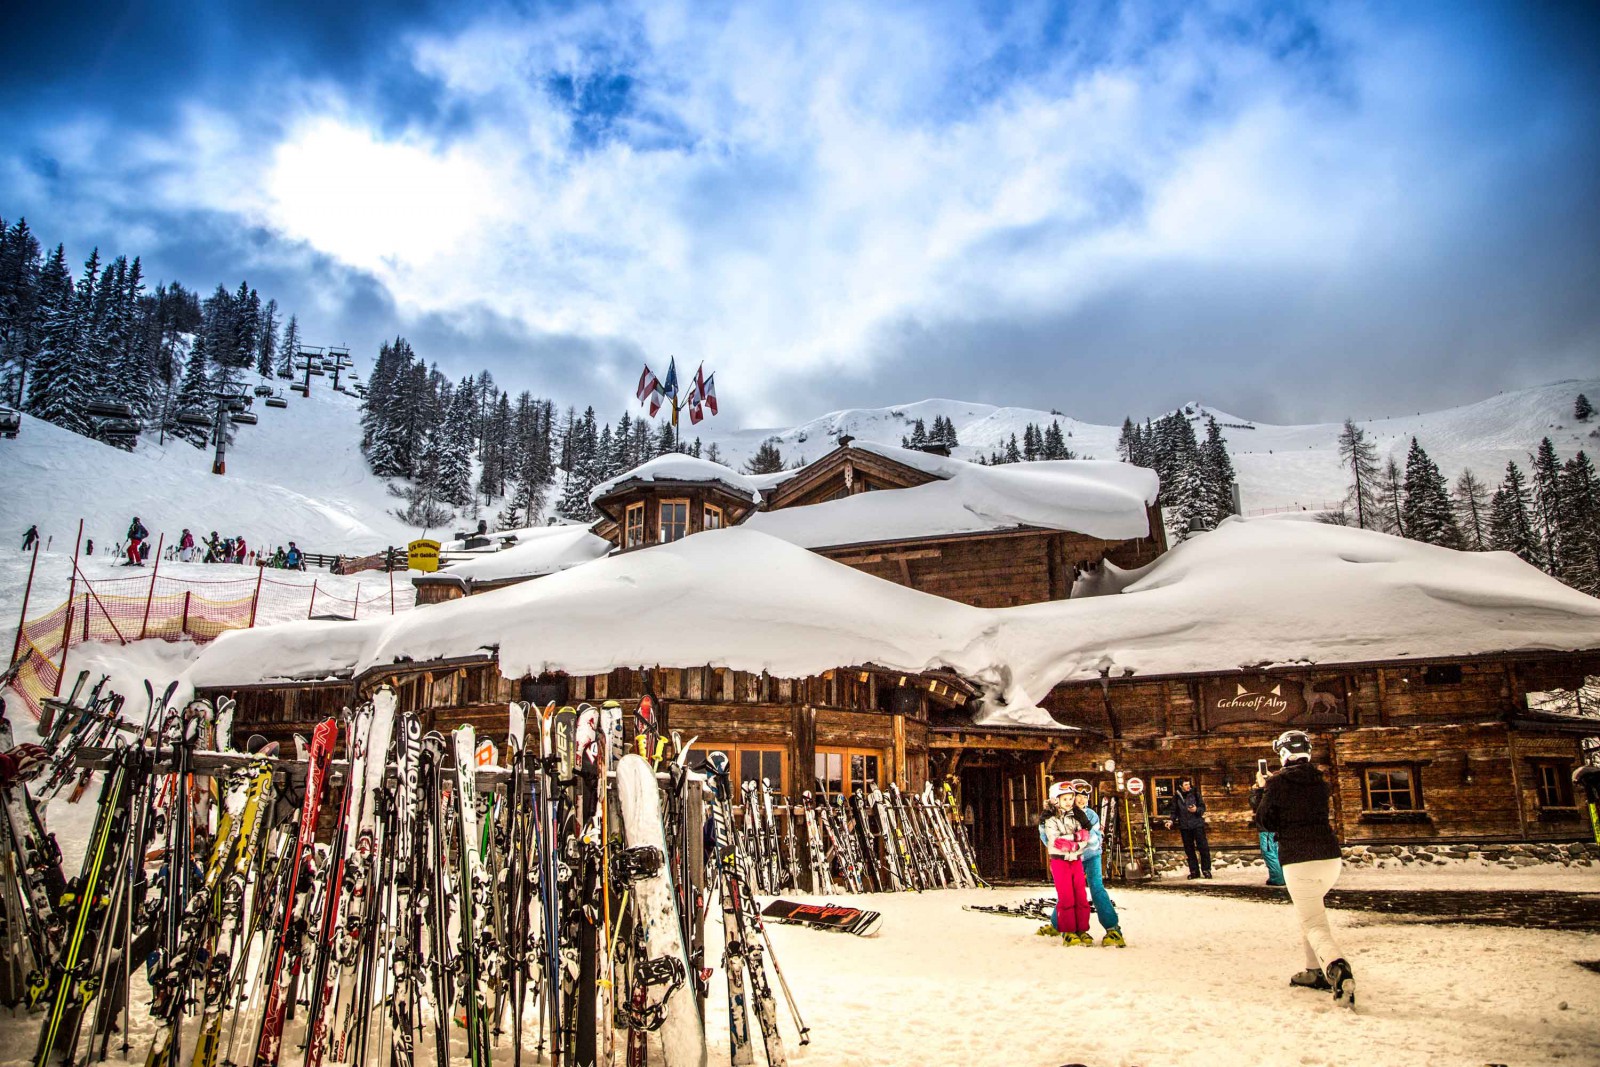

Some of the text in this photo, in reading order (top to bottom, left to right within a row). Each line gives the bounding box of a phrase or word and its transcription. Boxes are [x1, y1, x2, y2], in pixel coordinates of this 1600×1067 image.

[1217, 694, 1287, 714] Gehwolf Alm
[406, 719, 421, 821] ATOMIC
[247, 777, 271, 858] ATOMIC
[403, 1034, 413, 1053] 170
